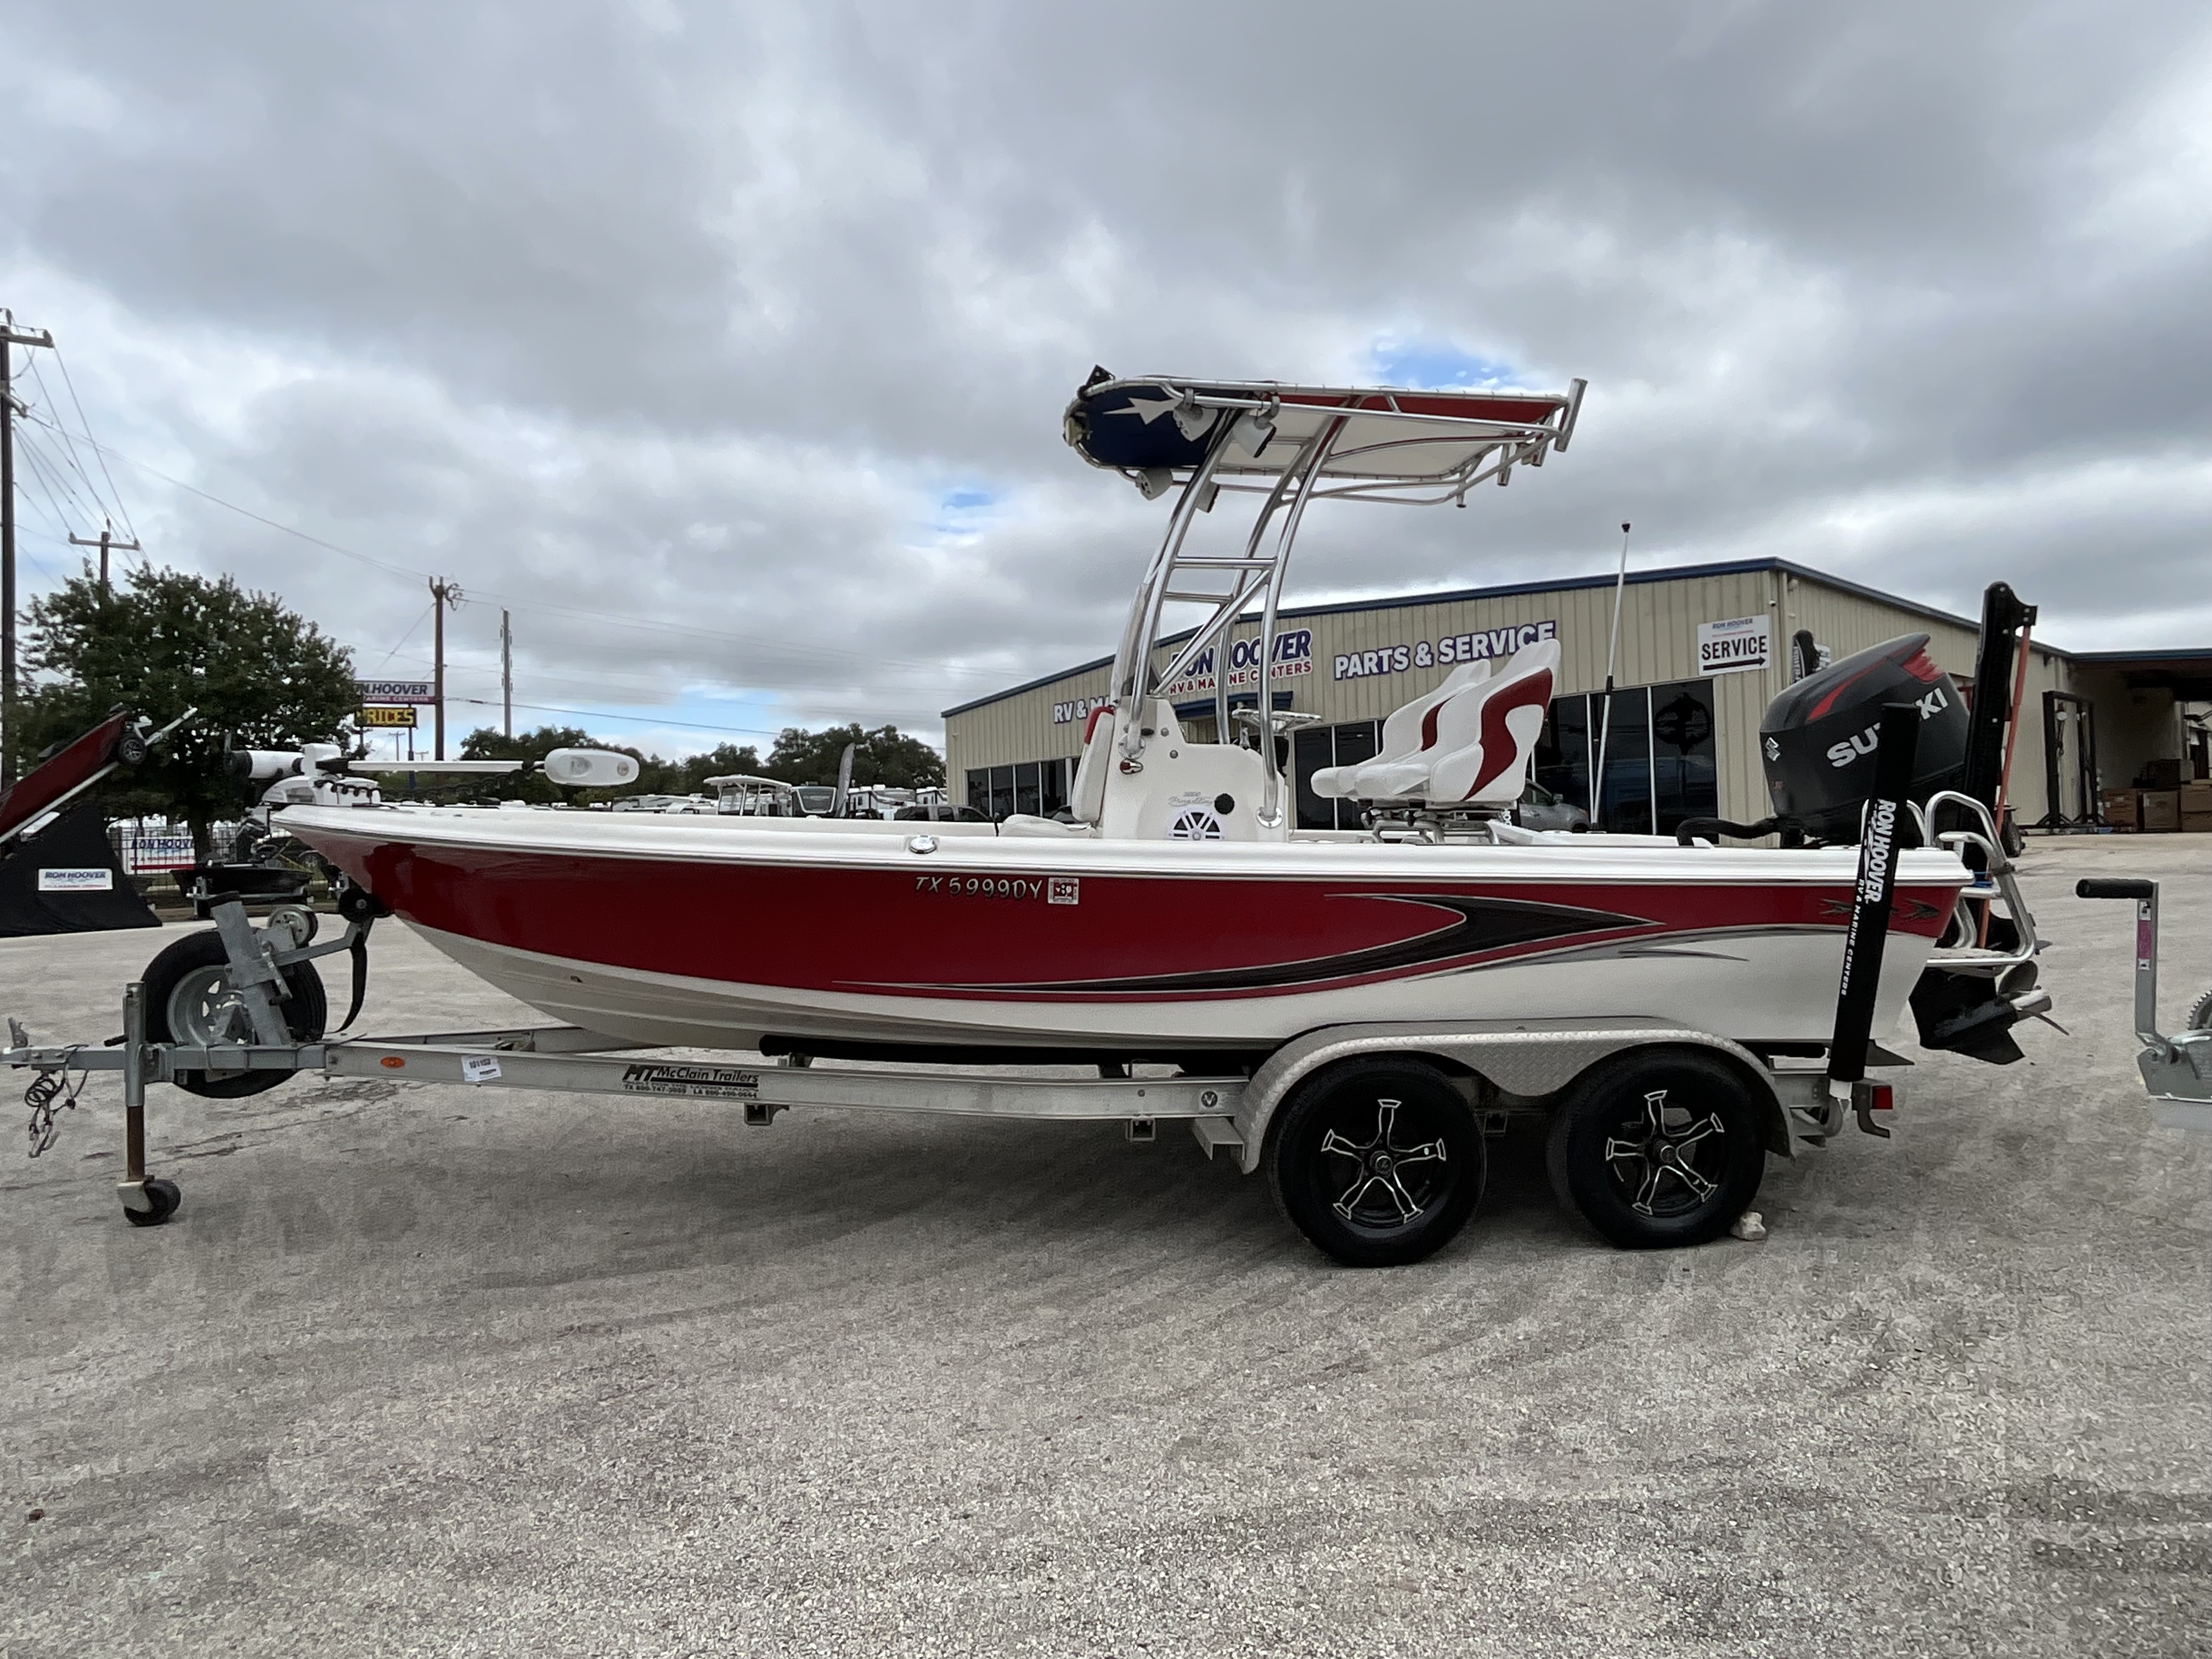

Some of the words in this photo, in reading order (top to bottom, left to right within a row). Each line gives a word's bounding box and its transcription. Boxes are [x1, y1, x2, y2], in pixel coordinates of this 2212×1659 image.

[1727, 618, 1753, 627] HOOVER
[1171, 647, 1214, 676] ON
[1335, 646, 1410, 680] PARTS
[1415, 641, 1433, 667] &
[1438, 620, 1556, 663] SERVICE
[1701, 635, 1768, 661] SERVICE
[372, 684, 428, 695] HOOVER
[1169, 682, 1185, 695] RV
[1187, 680, 1194, 691] &
[1198, 677, 1245, 691] MANE
[1250, 661, 1312, 681] CNTERS
[1054, 702, 1074, 724] RV
[1076, 699, 1088, 719] &
[1827, 687, 1948, 768] SUKI
[1875, 798, 1897, 836] RON
[1865, 834, 1889, 903] HOOVER
[916, 877, 943, 893] TX
[1858, 879, 1865, 894] RV
[1849, 905, 1861, 947] MARINE
[1841, 948, 1854, 996] CENTERS
[657, 1066, 709, 1080] McClain
[713, 1069, 759, 1083] Trailers
